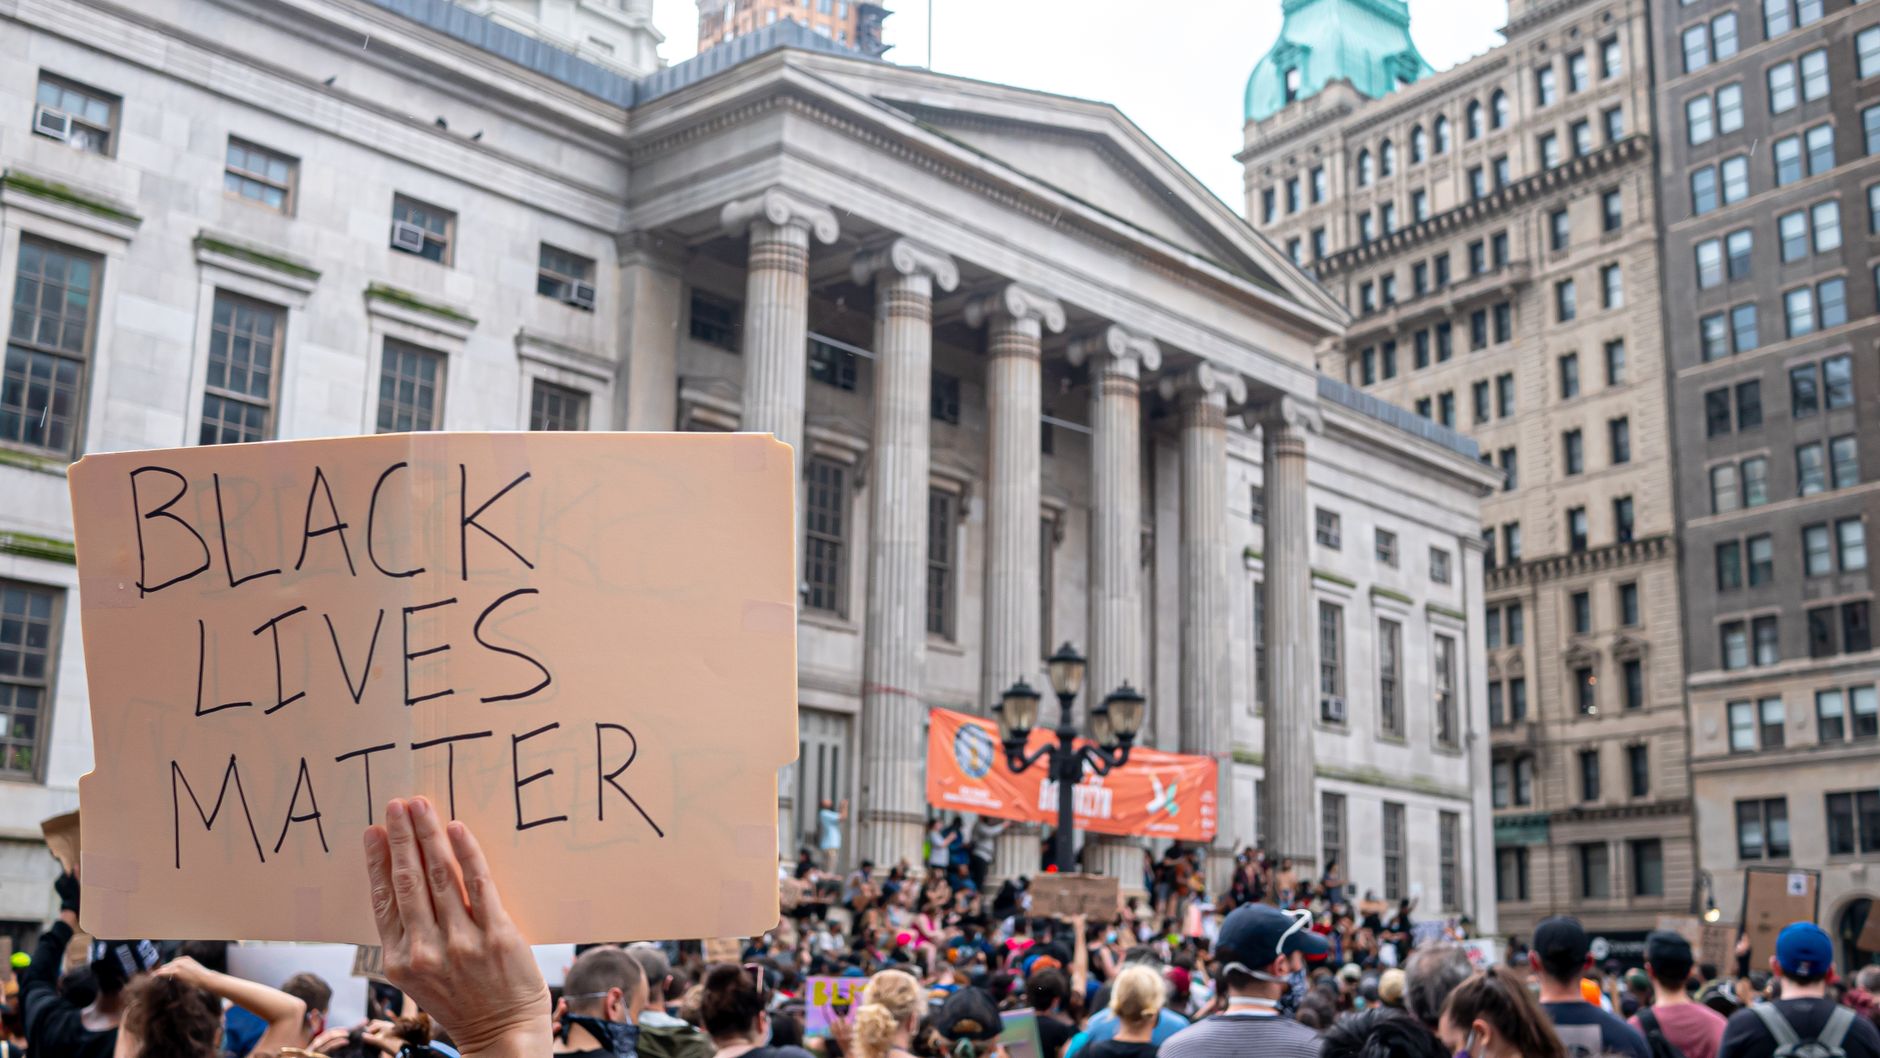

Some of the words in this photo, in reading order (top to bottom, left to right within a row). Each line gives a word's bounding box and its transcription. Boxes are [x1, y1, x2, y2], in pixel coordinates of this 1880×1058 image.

[130, 462, 534, 599] BLACK
[195, 588, 552, 718] LIVES
[171, 722, 664, 870] MATTER
